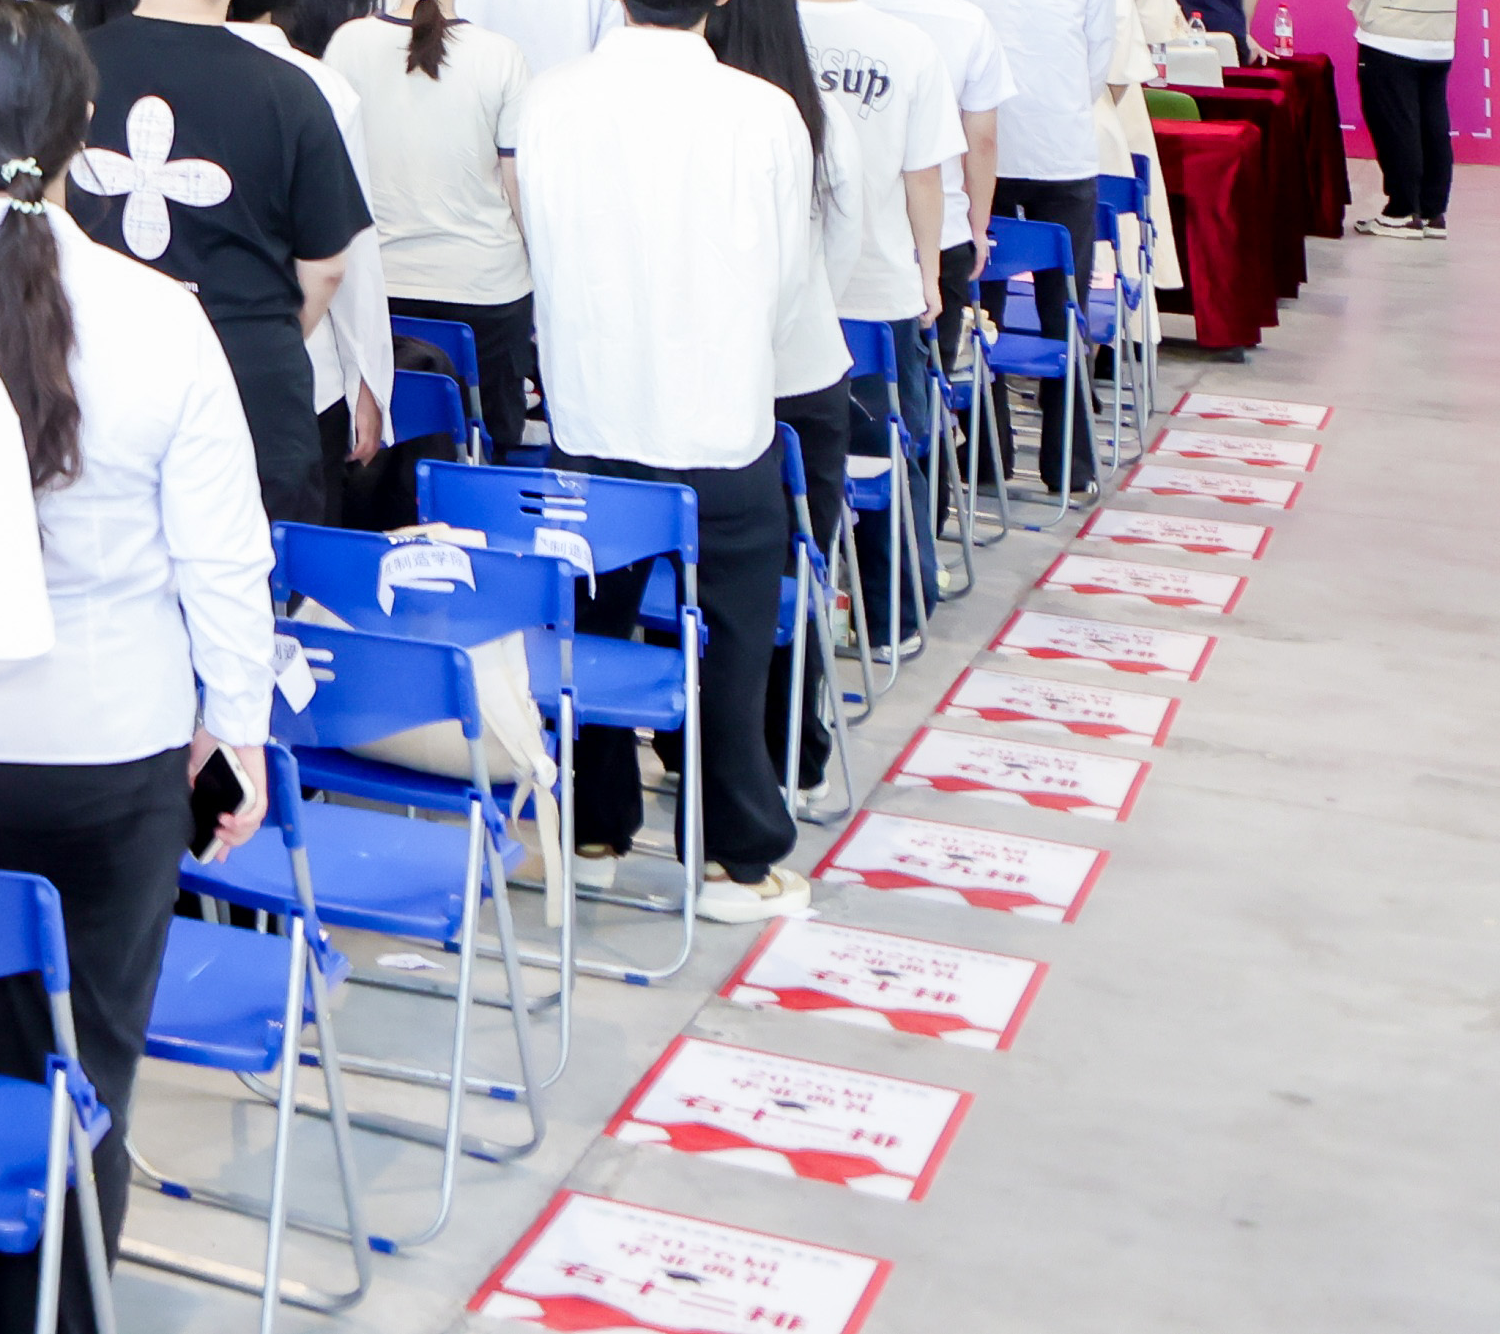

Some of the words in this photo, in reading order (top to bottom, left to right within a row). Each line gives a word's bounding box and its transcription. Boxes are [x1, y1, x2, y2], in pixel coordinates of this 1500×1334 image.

[809, 967, 960, 1005] 右十排
[675, 1094, 902, 1148] 右十一排
[557, 1262, 807, 1331] 右十二排
